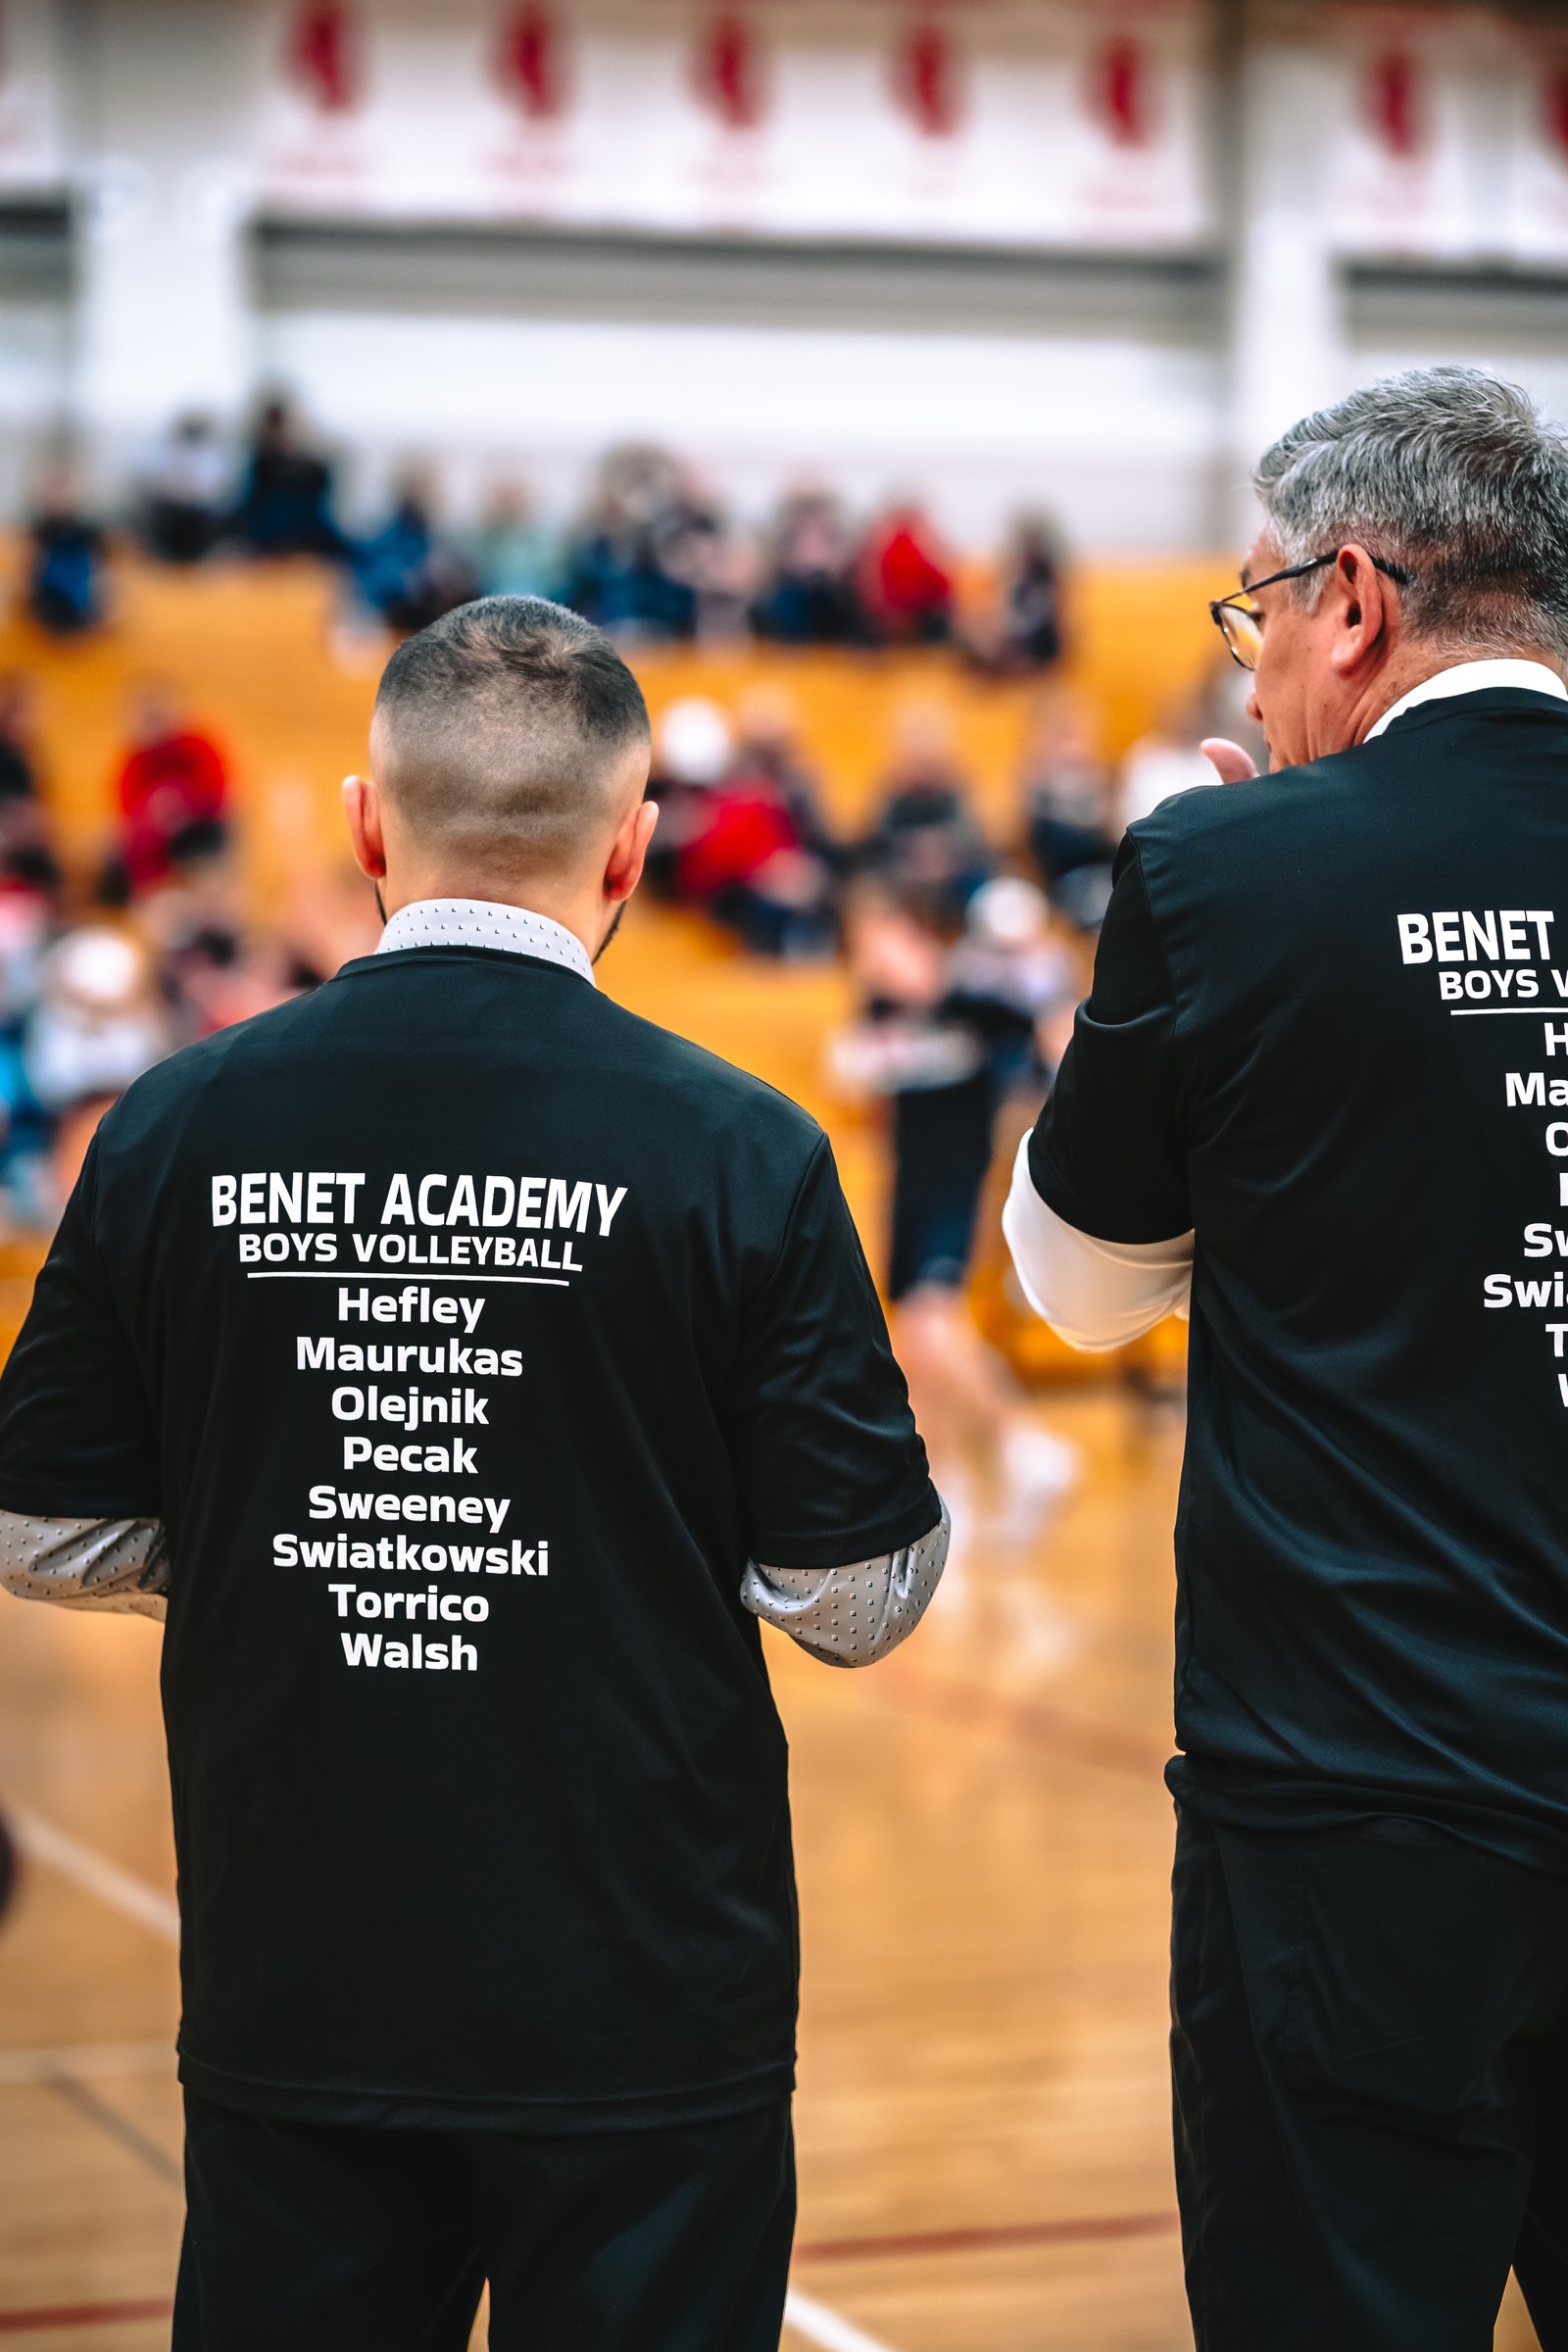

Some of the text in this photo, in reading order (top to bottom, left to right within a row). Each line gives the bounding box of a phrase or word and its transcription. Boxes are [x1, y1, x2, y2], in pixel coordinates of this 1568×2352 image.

[1397, 910, 1554, 964] BENET
[1439, 969, 1539, 1000] BOYS
[212, 1173, 628, 1236] BENET ACADEMY
[239, 1233, 582, 1271] BOYS VOLLEYBALL
[1484, 1272, 1568, 1307] Swi
[339, 1286, 485, 1333] Hefley
[297, 1337, 522, 1376] Maurukas
[332, 1386, 489, 1431] Olejnik
[344, 1437, 478, 1473] Pecak
[310, 1486, 511, 1533] Sweeney
[273, 1534, 548, 1575] Swiatkowski
[328, 1584, 489, 1622] Torrico
[341, 1633, 477, 1671] Walsh
